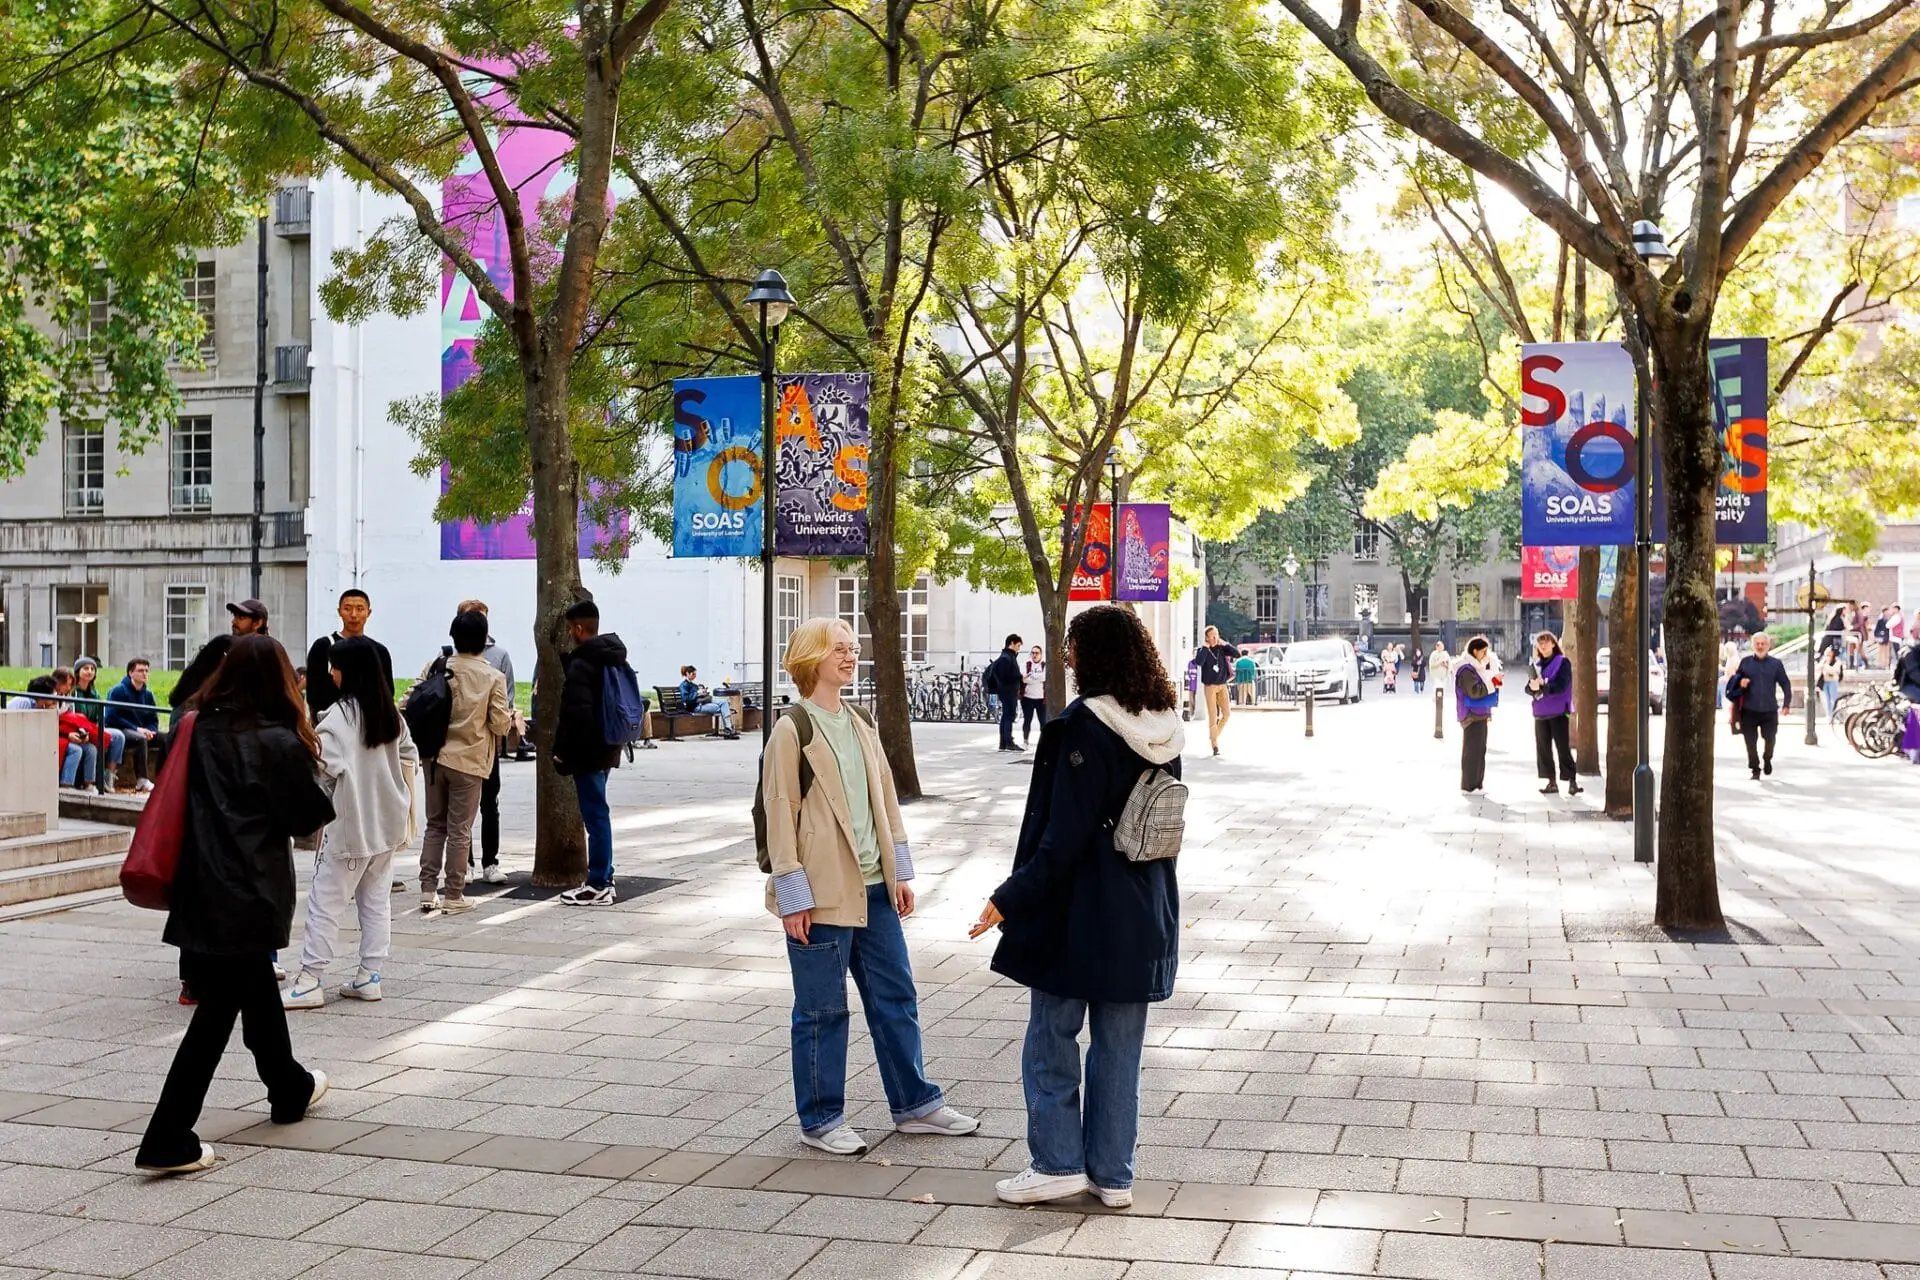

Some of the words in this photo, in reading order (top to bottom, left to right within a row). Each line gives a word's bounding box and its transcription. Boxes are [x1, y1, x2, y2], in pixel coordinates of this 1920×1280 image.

[1522, 354, 1566, 427] S
[674, 389, 707, 451] S
[777, 384, 823, 452] A
[1565, 421, 1637, 493] O
[1720, 418, 1767, 493] S
[707, 446, 764, 511] O
[831, 446, 869, 511] S
[1546, 495, 1612, 515] SOAS
[1715, 494, 1751, 507] orld's
[692, 512, 744, 529] SOAS
[790, 512, 811, 522] The
[814, 511, 854, 522] World's
[1715, 508, 1745, 523] rsity
[795, 524, 849, 537] University
[1070, 576, 1101, 587] SOAS
[1534, 572, 1568, 584] SOAS
